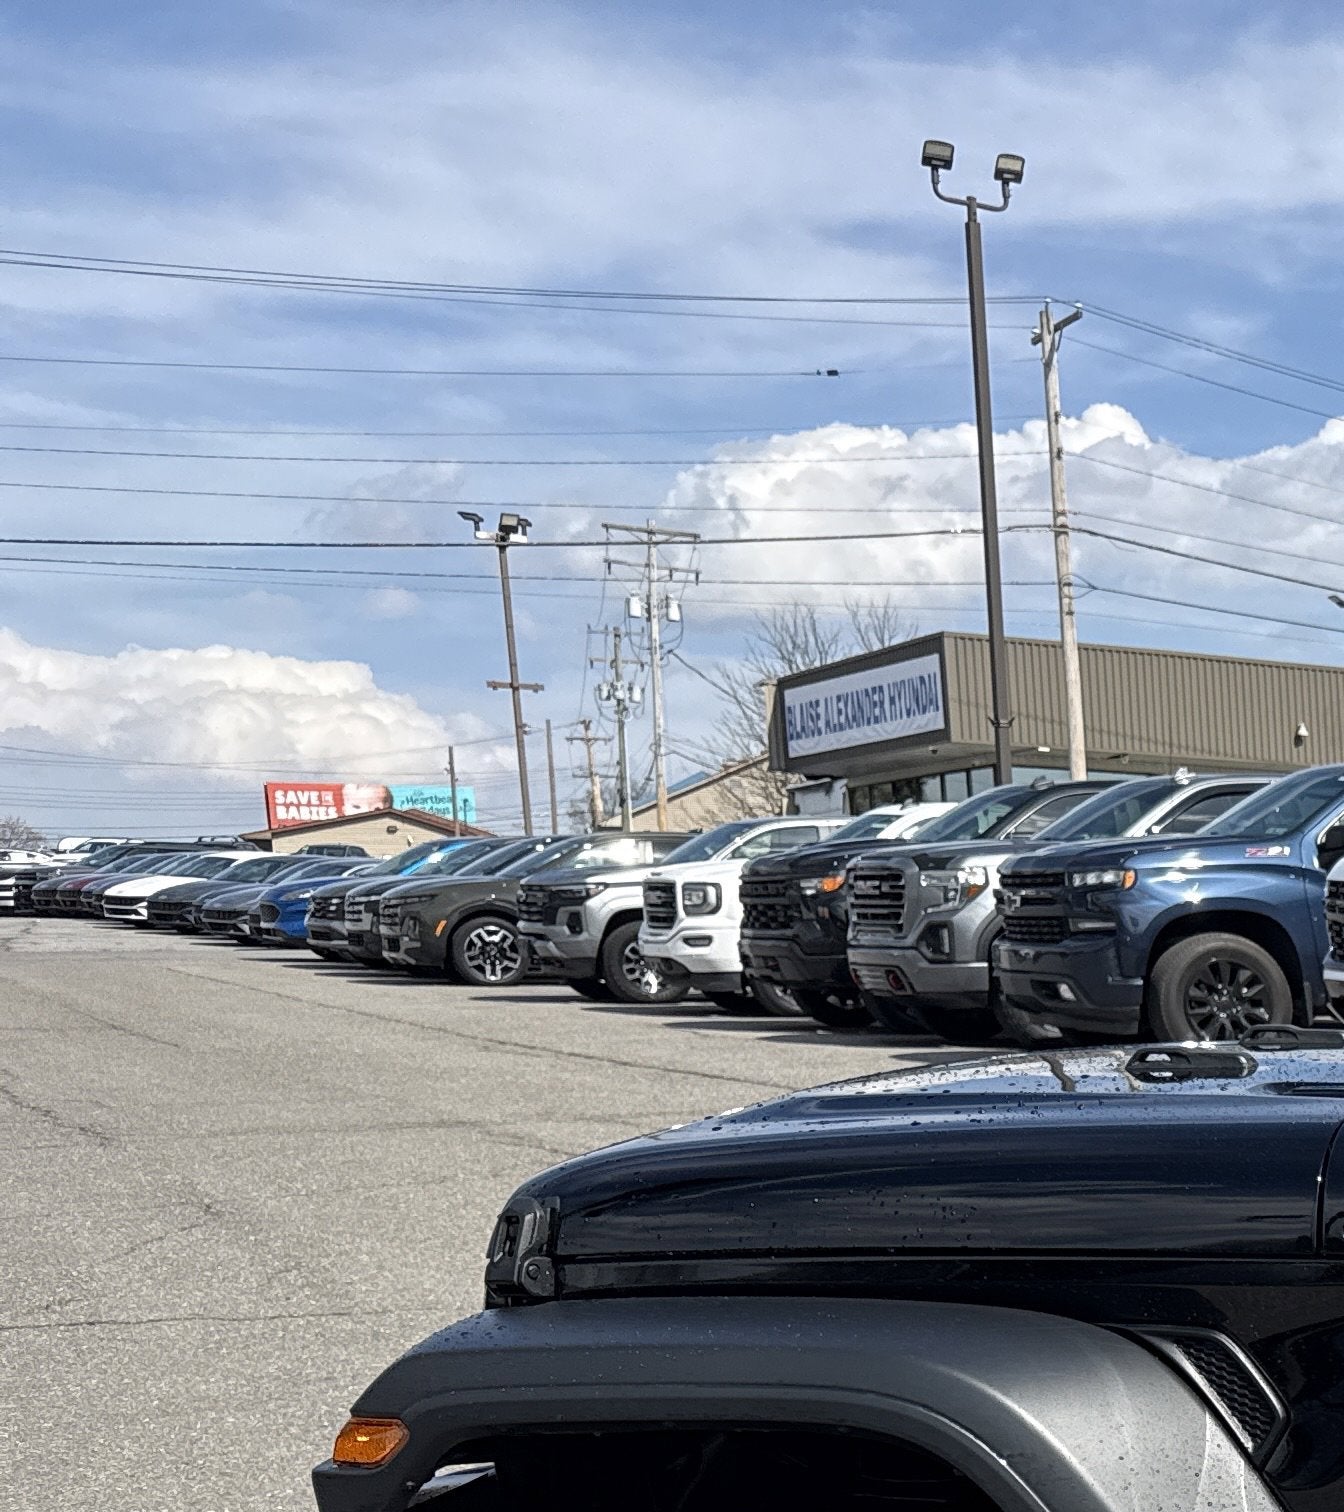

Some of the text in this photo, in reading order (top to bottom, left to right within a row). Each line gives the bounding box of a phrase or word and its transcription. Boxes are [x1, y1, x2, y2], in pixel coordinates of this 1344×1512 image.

[787, 672, 939, 741] BLAISE ALEXANDER HYUNDAI
[274, 790, 320, 805] SAVE
[405, 795, 455, 807] Heartbea
[276, 805, 338, 820] BABIES
